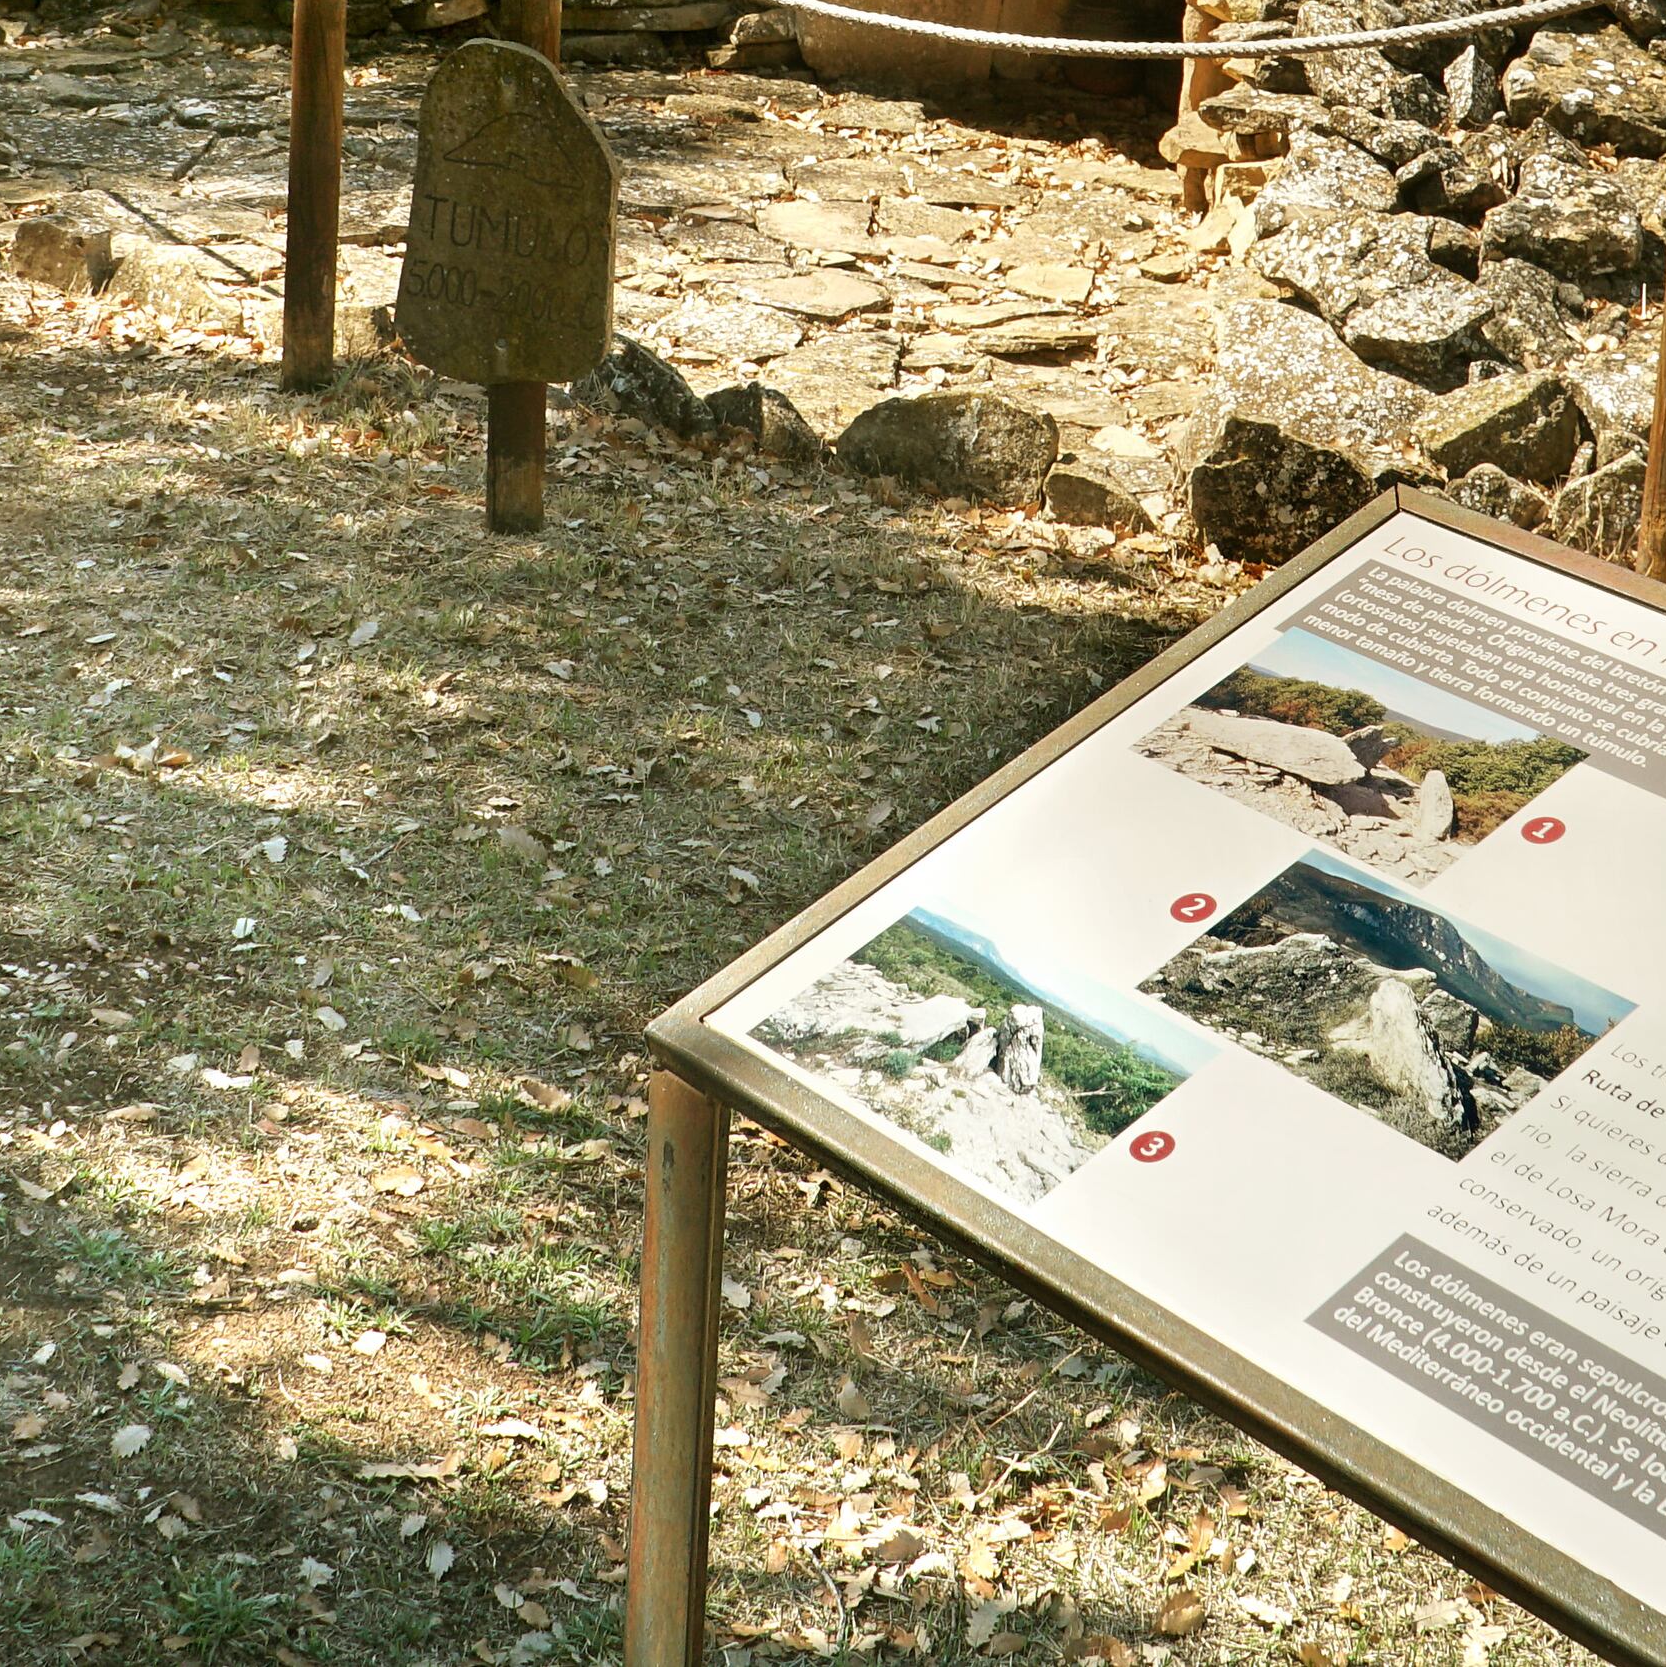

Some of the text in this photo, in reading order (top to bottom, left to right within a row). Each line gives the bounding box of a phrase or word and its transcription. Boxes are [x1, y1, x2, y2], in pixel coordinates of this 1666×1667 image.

[1367, 565, 1389, 581] La
[1383, 575, 1447, 605] palabra
[1445, 598, 1508, 630] dolmen
[1503, 624, 1581, 660] proviene
[1579, 653, 1614, 672] del
[1381, 535, 1443, 569] Los
[1442, 564, 1608, 635] dólmenes
[1608, 630, 1658, 657] en
[1400, 598, 1425, 614] de
[1485, 633, 1603, 688] Originalmente
[1601, 680, 1639, 703] tres
[1302, 613, 1646, 768] menor tamaño y tierra formando un túmulo.
[1318, 602, 1367, 627] modo
[1364, 621, 1389, 636] de
[1387, 631, 1454, 666] cubierta.
[1459, 657, 1500, 683] Todo
[1499, 678, 1523, 692] el
[1517, 686, 1593, 723] conjunto
[1590, 717, 1616, 733] se
[1333, 588, 1428, 634] (ortostatos)
[1422, 627, 1503, 666] sujetaban
[1501, 659, 1537, 680] una
[1534, 671, 1625, 715] horizontal
[1620, 710, 1646, 726] en
[1644, 717, 1666, 734] la
[1531, 821, 1554, 839] 1
[1180, 897, 1207, 917] 2
[1139, 1136, 1165, 1157] 3
[1549, 1094, 1572, 1112] Si
[1573, 1109, 1654, 1155] quieres
[1580, 1068, 1633, 1103] Ruta
[1635, 1098, 1666, 1119] de
[1489, 1151, 1516, 1166] el
[1512, 1163, 1544, 1183] de
[1544, 1176, 1596, 1212] Losa
[1597, 1204, 1660, 1246] Mora
[1373, 1270, 1504, 1352] construyeron
[1503, 1345, 1569, 1389] desde
[1568, 1383, 1597, 1403] el
[1393, 1249, 1431, 1279] Los
[1429, 1272, 1530, 1336] dólmenes
[1528, 1330, 1578, 1364] eran
[1332, 1305, 1373, 1333] del
[1365, 1322, 1504, 1414] Mediterráneo
[1504, 1408, 1620, 1480] occidental
[1611, 1472, 1634, 1491] y
[1631, 1479, 1656, 1505] la
[1352, 1284, 1424, 1336] Bronce
[1420, 1325, 1557, 1411] (4.000-1.700
[1551, 1405, 1607, 1445] a.C.).
[1608, 1435, 1640, 1463] Se
